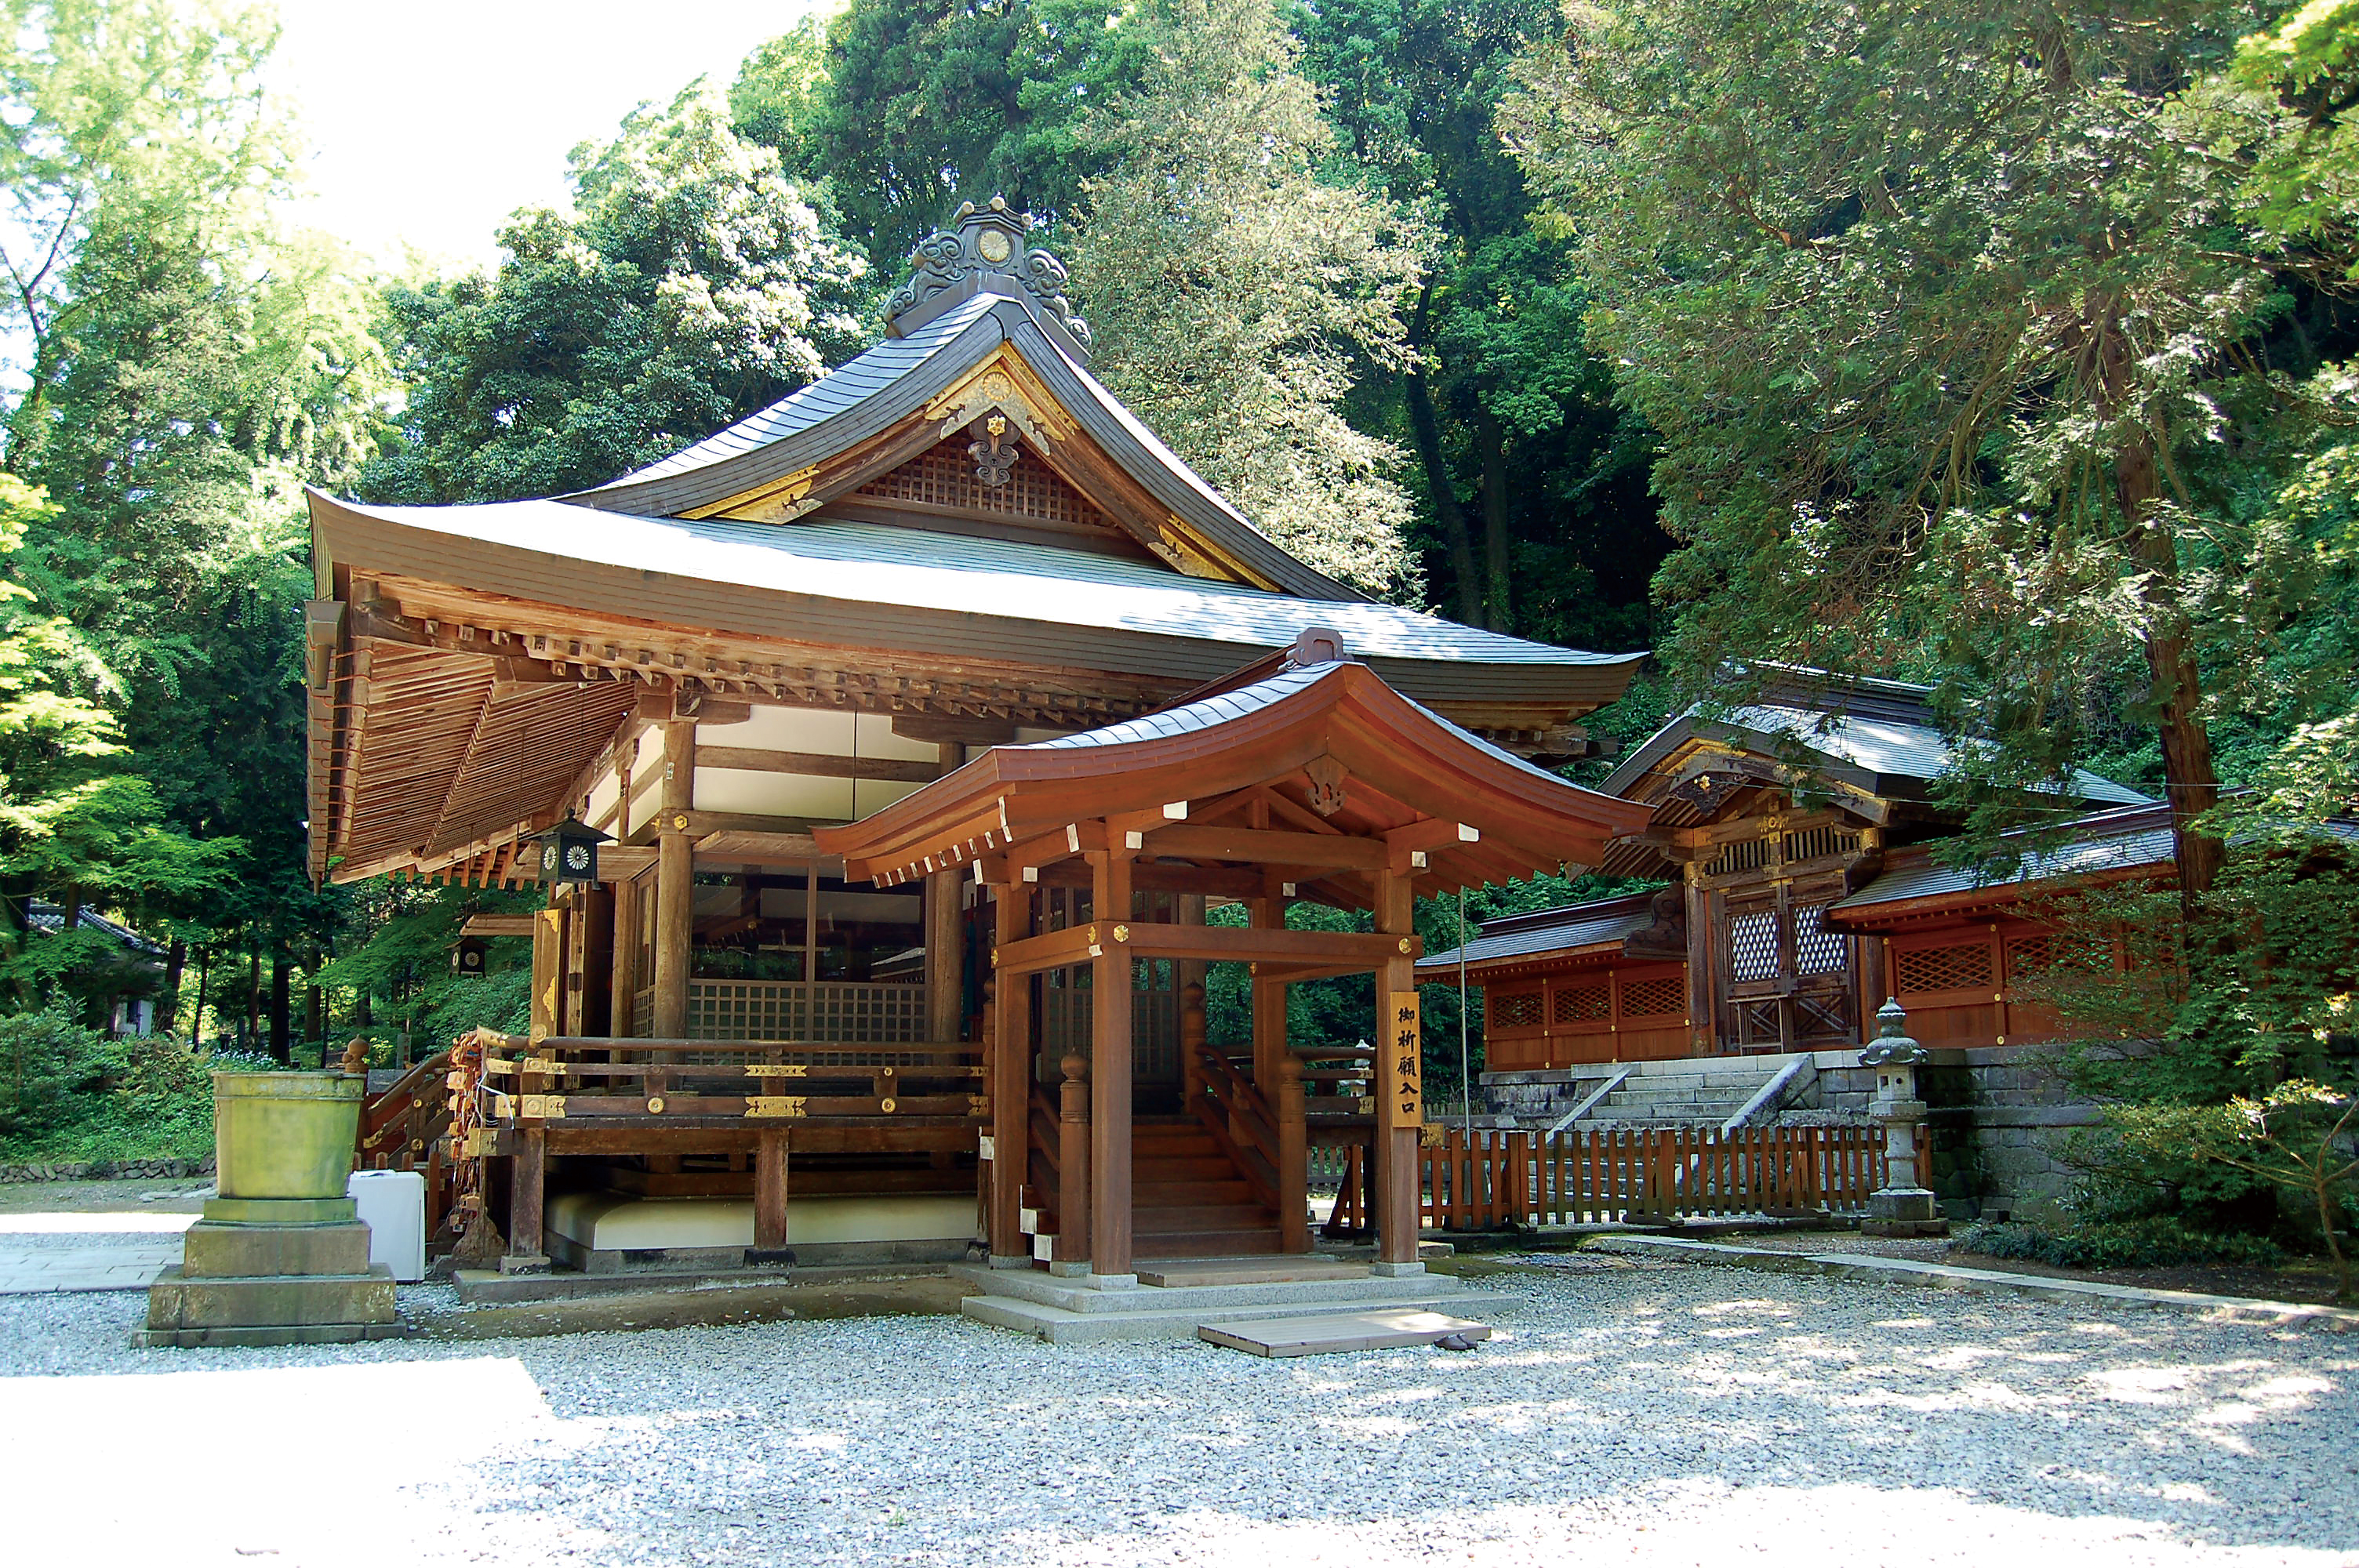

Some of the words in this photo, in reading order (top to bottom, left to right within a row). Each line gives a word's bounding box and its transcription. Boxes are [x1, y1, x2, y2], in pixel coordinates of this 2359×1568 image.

[1397, 1007, 1418, 1113] 御祈願入口
